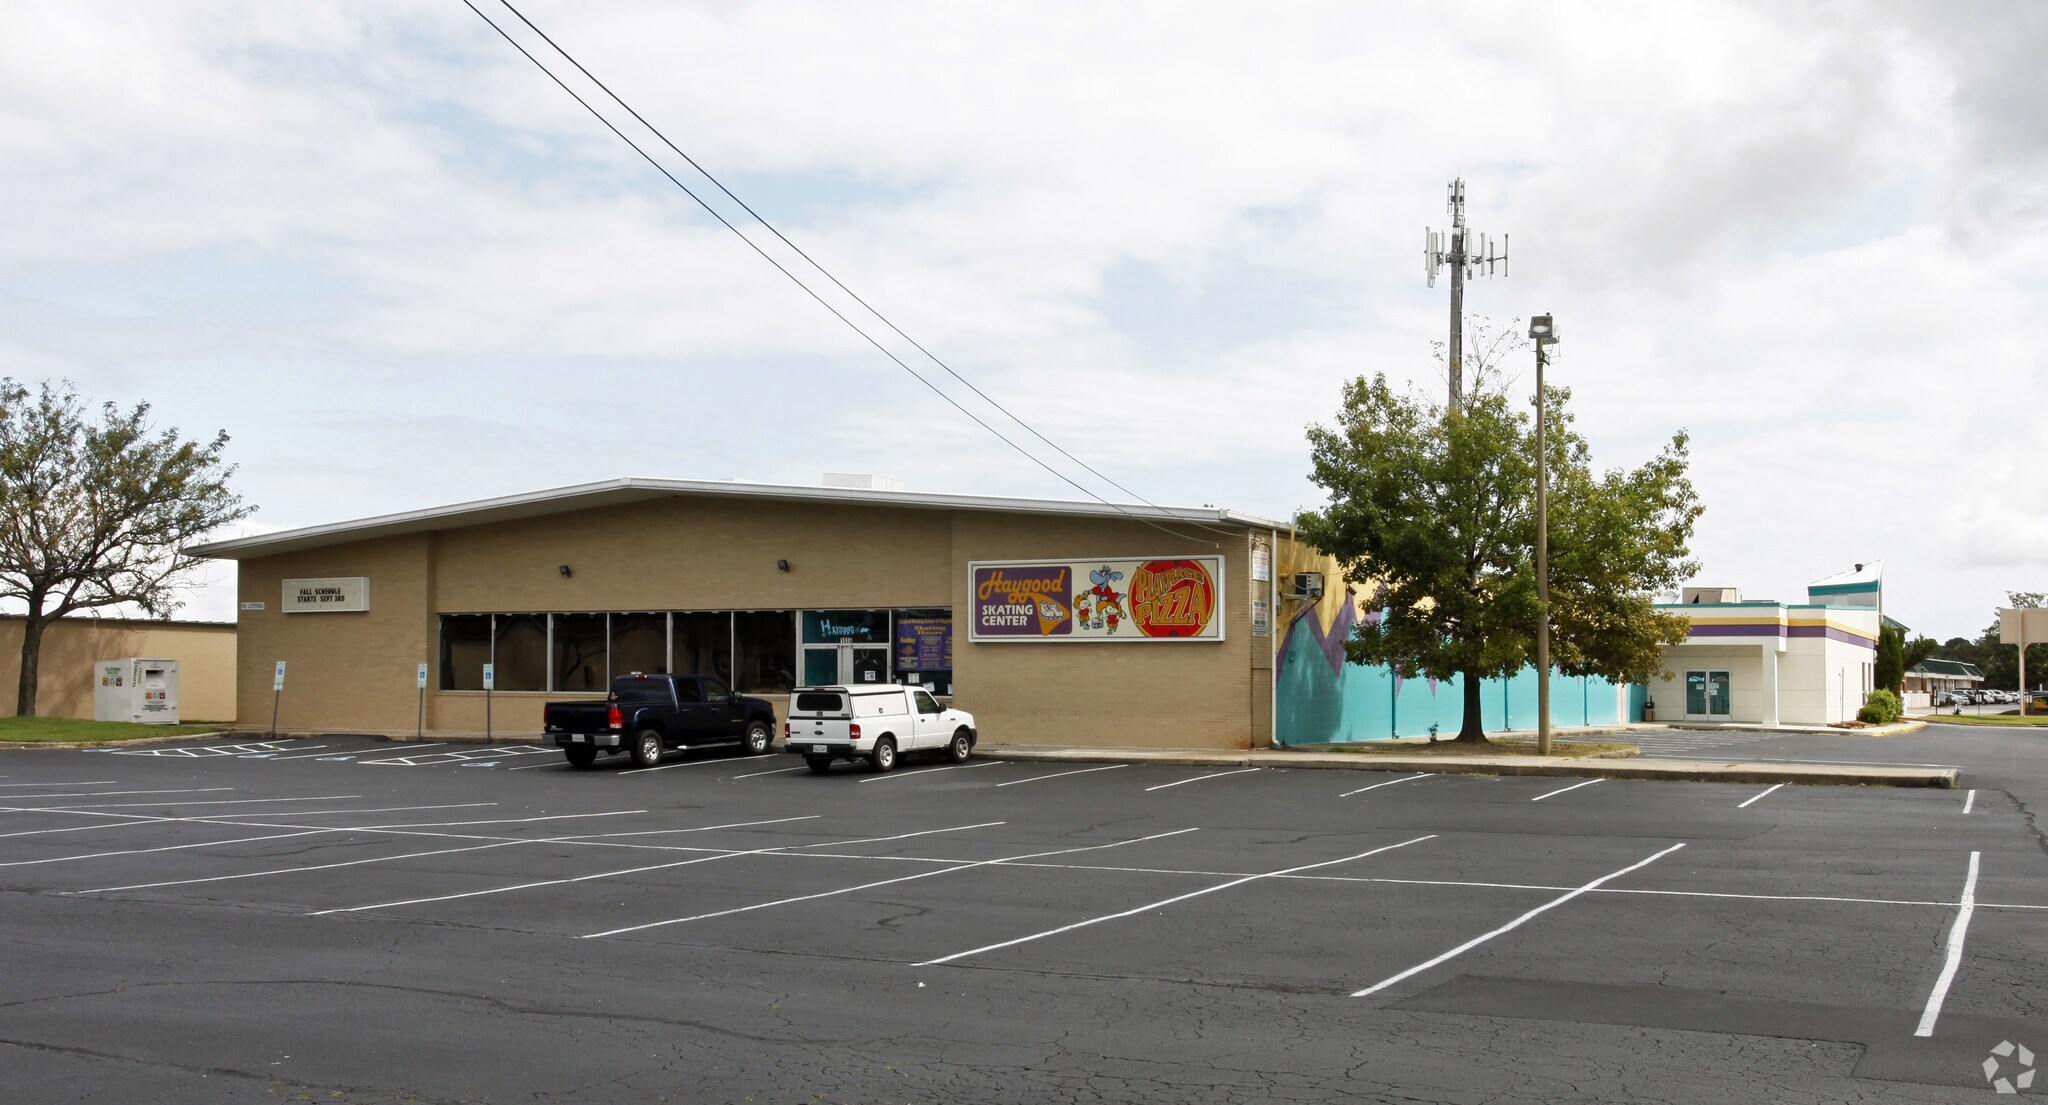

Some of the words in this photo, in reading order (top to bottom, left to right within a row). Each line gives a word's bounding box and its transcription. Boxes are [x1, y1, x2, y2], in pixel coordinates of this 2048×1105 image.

[978, 569, 1064, 604] Haygood
[1136, 565, 1205, 602] PLAYPLACE
[297, 595, 317, 603] STARTS
[982, 604, 1033, 615] SKATING
[1135, 583, 1209, 626] PIZZA
[982, 616, 1028, 626] CENTER
